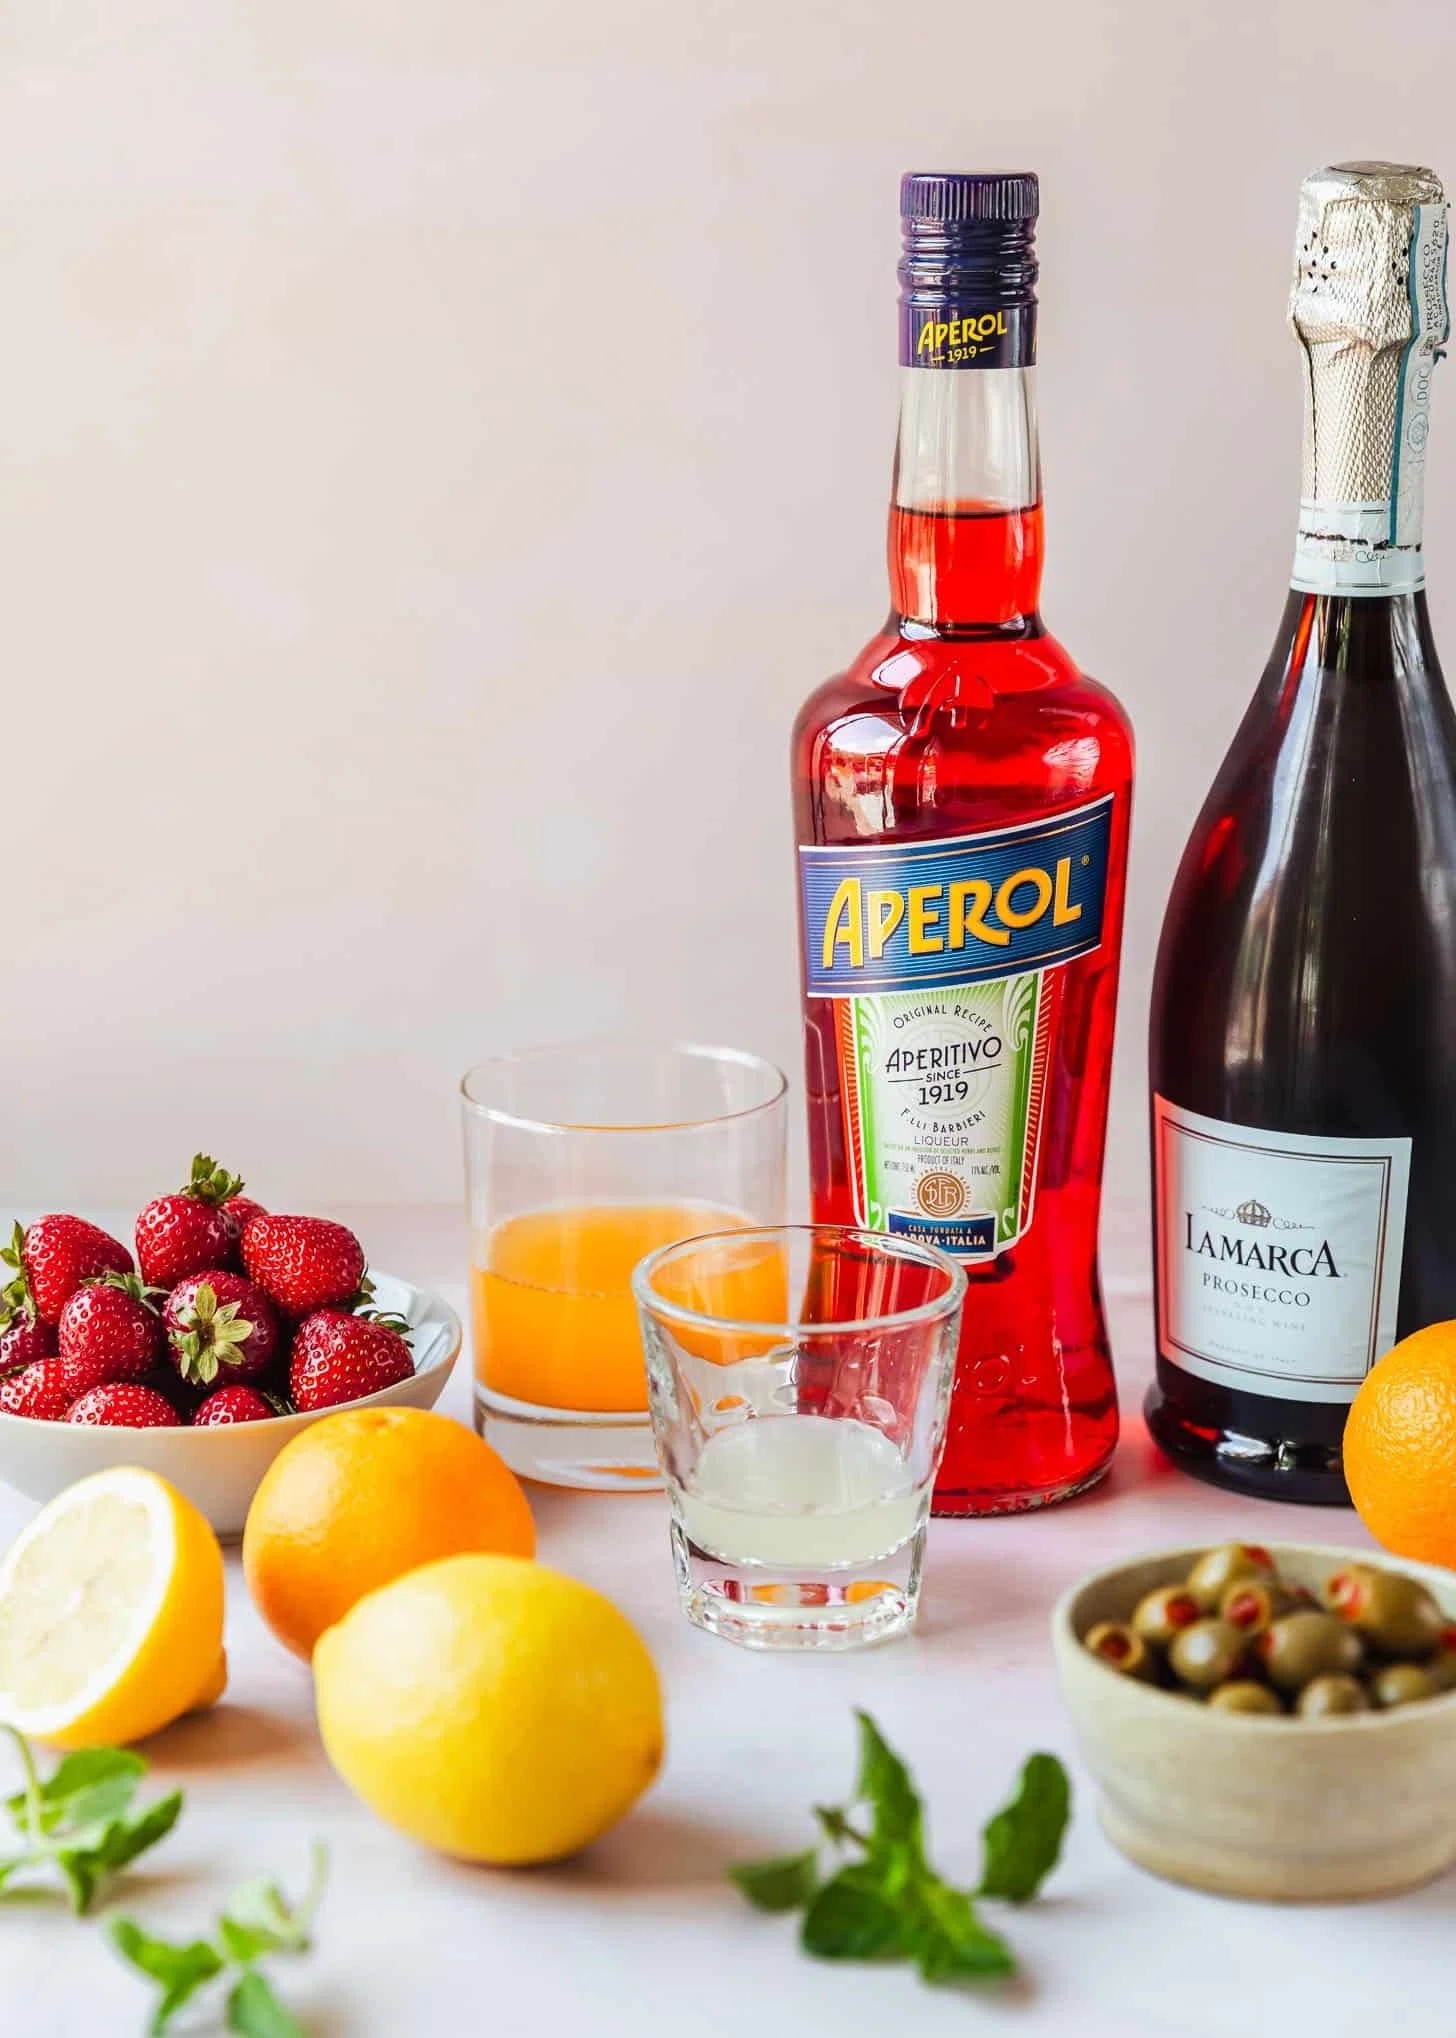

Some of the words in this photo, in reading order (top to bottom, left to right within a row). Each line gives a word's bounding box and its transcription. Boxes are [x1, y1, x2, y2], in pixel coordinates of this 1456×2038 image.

[1423, 243, 1433, 330] PROSECCO
[917, 311, 1008, 355] APEROL
[947, 345, 977, 363] 1919
[1416, 369, 1429, 401] DOC
[822, 856, 1083, 969] APEROL
[893, 1004, 947, 1029] ORIGINAL
[954, 1004, 993, 1033] RECIPE
[885, 1036, 1002, 1073] APERITIVO
[926, 1069, 961, 1083] SINCE
[919, 1081, 969, 1106] 1919
[933, 1110, 986, 1134] BARBIERI
[914, 1135, 968, 1147] LIQUEUR
[1202, 1271, 1311, 1307] PROSECCO
